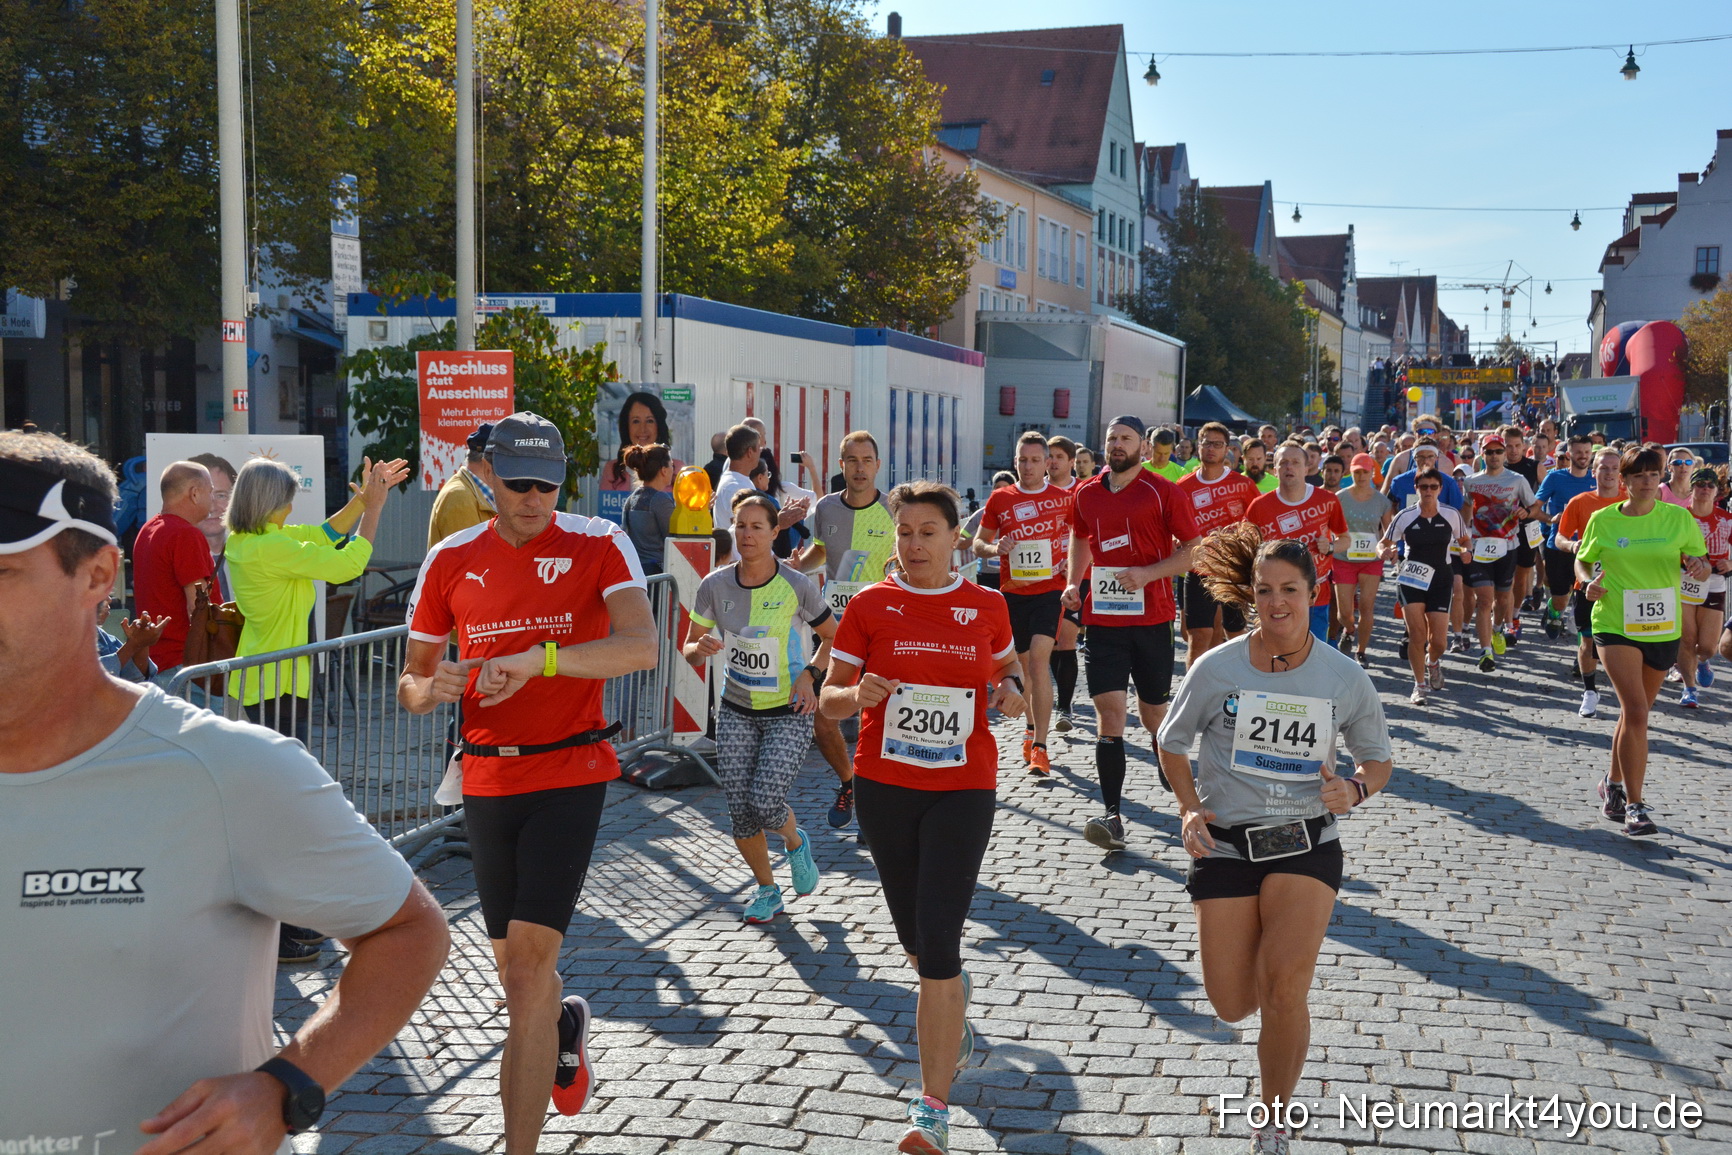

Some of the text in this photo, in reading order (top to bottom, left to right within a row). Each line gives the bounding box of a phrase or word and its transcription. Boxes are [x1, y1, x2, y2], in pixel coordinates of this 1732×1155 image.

[10, 317, 30, 327] Mode
[262, 354, 270, 374] 3
[426, 360, 508, 375] Abschluss
[426, 376, 454, 386] statt
[1442, 371, 1480, 380] START
[427, 386, 508, 400] Ausschluss!
[145, 401, 182, 412] STREB
[442, 407, 505, 416] Mehr Lehrer für
[438, 418, 472, 426] kleinere
[514, 438, 550, 448] TRISTAR
[1007, 520, 1054, 540] mbox
[1356, 540, 1370, 548] 157
[1484, 545, 1496, 554] 42
[1018, 552, 1042, 564] 112
[1406, 562, 1429, 578] 3062
[1098, 580, 1136, 595] 244
[1637, 602, 1664, 617] 153
[466, 618, 522, 634] ENGELHARDT
[468, 636, 497, 645] Amberg
[894, 640, 939, 648] ENGELHARDT
[730, 647, 770, 670] 2900
[738, 675, 760, 686] Andrea
[913, 692, 950, 704] BOCK
[1266, 700, 1308, 714] BOCK
[897, 706, 960, 736] 2304
[1248, 716, 1317, 748] 2144
[902, 733, 946, 745] PARTL Neumarkt
[908, 745, 944, 760] Bettina
[1254, 744, 1302, 756] PARTL Neumarkt
[1255, 755, 1302, 772] Susanne
[1266, 784, 1292, 798] 19.
[1266, 795, 1318, 806] Neumarkter
[1265, 806, 1310, 816] Stadtlauf
[22, 868, 145, 898] BOCK
[20, 896, 145, 909] inspired by smart concepts
